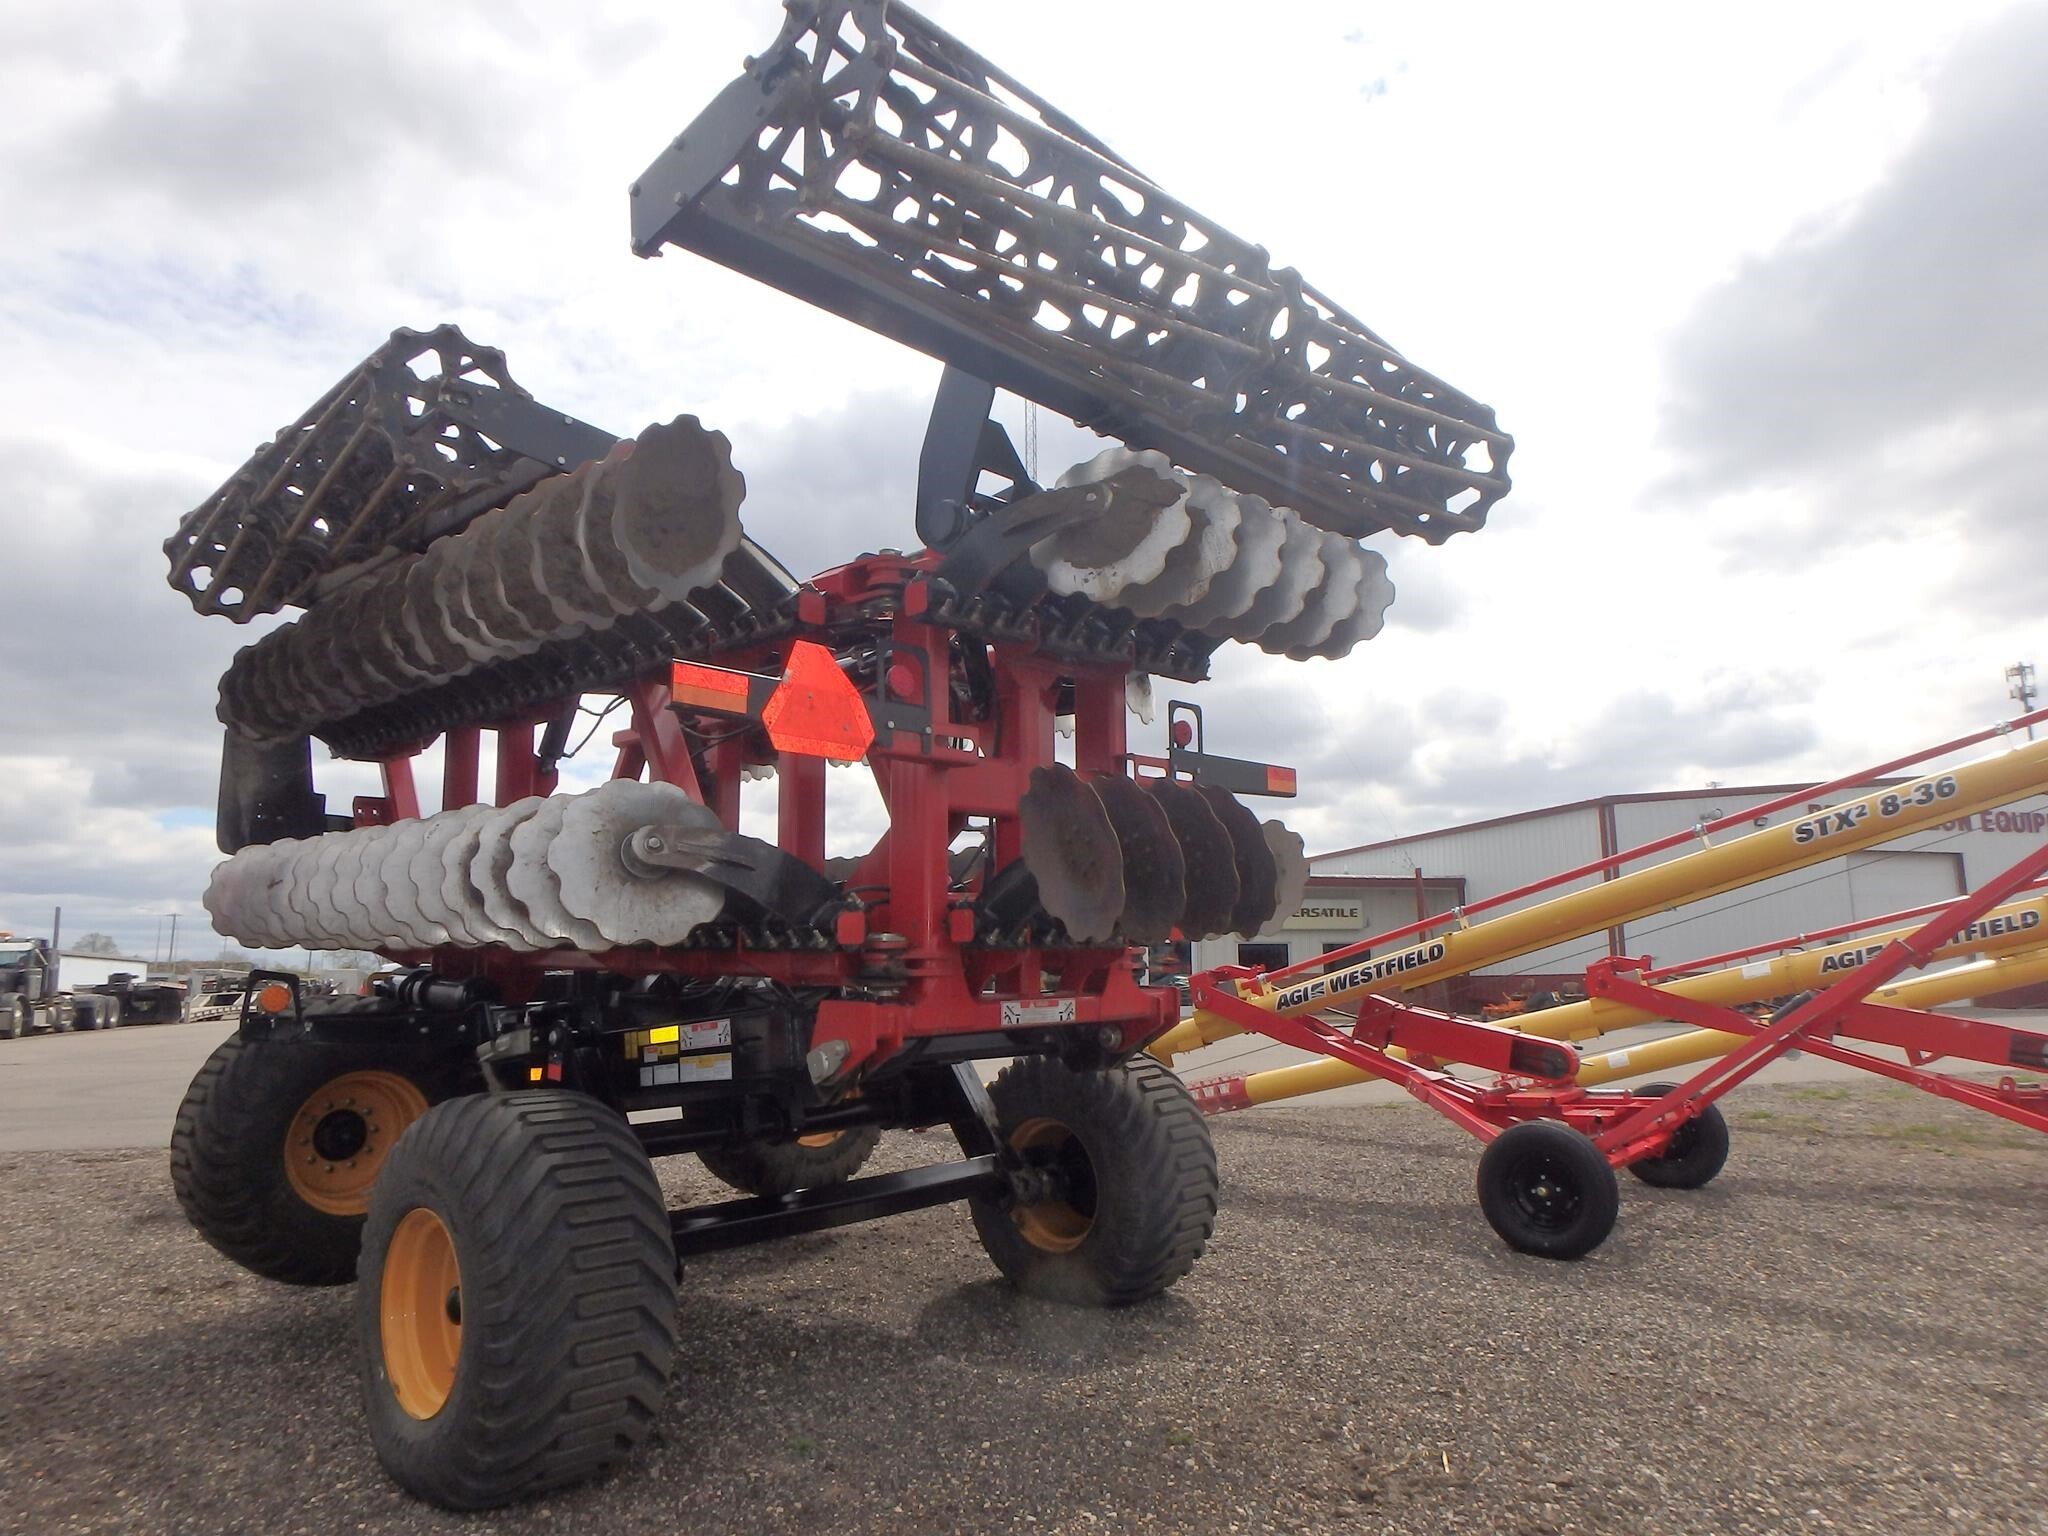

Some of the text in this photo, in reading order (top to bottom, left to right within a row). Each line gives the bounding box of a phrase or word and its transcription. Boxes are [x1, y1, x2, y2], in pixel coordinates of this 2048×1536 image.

[1879, 776, 1956, 816] 8-36
[1980, 810, 2048, 833] EQUIP
[1292, 907, 1358, 918] RSATILE
[1821, 910, 2040, 973] AGI FIELD
[1276, 943, 1444, 1011] AGI WESTFIELD
